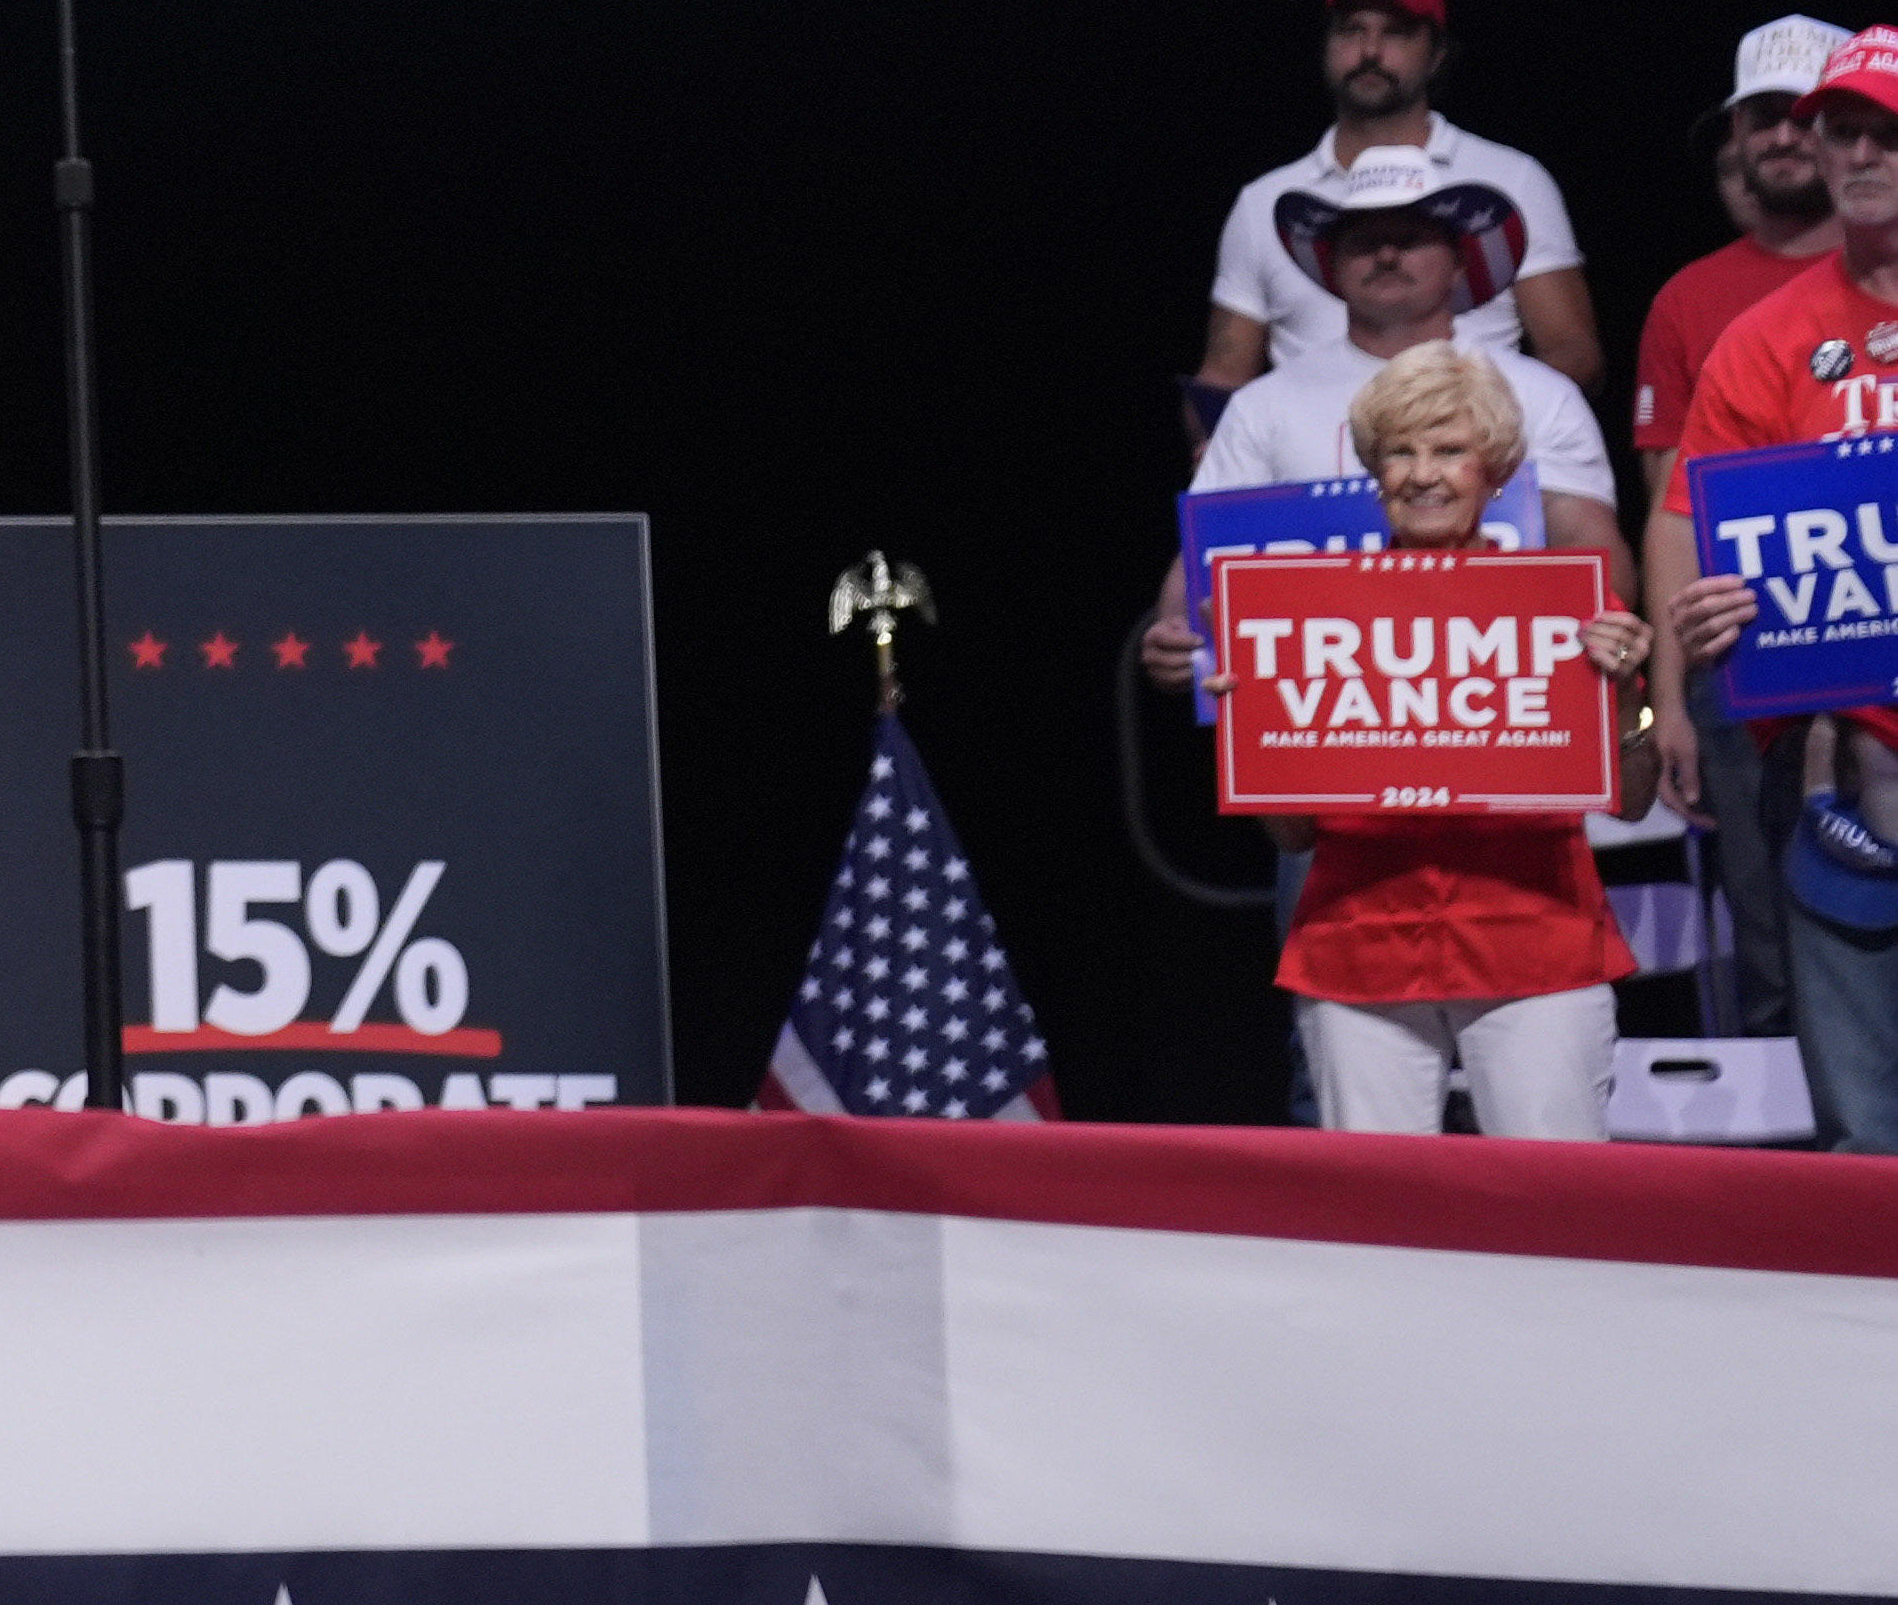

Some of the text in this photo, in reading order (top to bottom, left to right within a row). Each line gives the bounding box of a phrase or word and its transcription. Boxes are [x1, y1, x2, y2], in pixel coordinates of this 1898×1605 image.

[1717, 501, 1898, 580] TRU
[1237, 615, 1584, 680] TRUMP
[1756, 626, 1819, 649] MAKE
[1277, 676, 1552, 729] VANCE
[1260, 729, 1572, 749] MAKE AMERICA GREAT AGAIN!
[1379, 786, 1451, 808] 2024
[124, 857, 471, 1037] 15%
